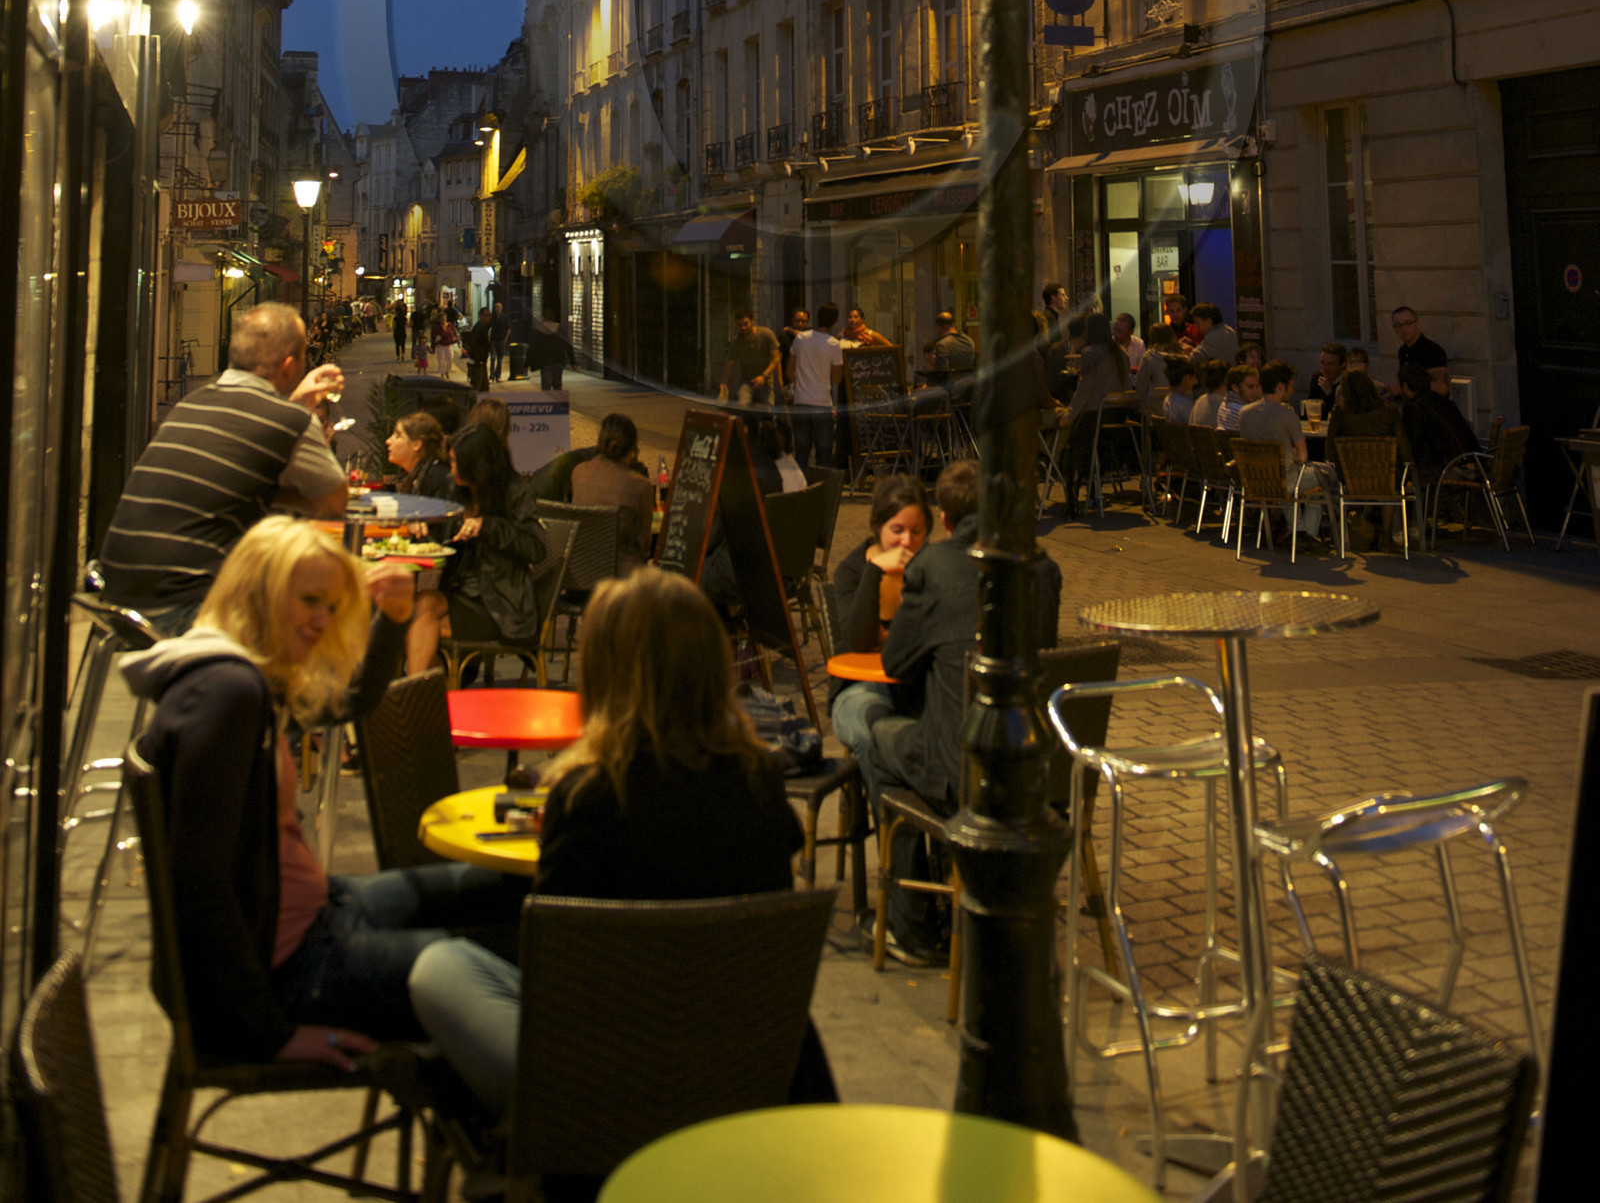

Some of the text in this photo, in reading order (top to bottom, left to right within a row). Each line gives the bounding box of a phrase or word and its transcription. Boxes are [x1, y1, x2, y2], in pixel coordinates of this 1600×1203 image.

[1103, 91, 1160, 137] CHEZ
[177, 202, 236, 221] BIJOUX
[725, 244, 745, 252] VENTE
[1156, 255, 1169, 268] BAR
[508, 405, 553, 413] MPREVU
[529, 423, 549, 432] 22h
